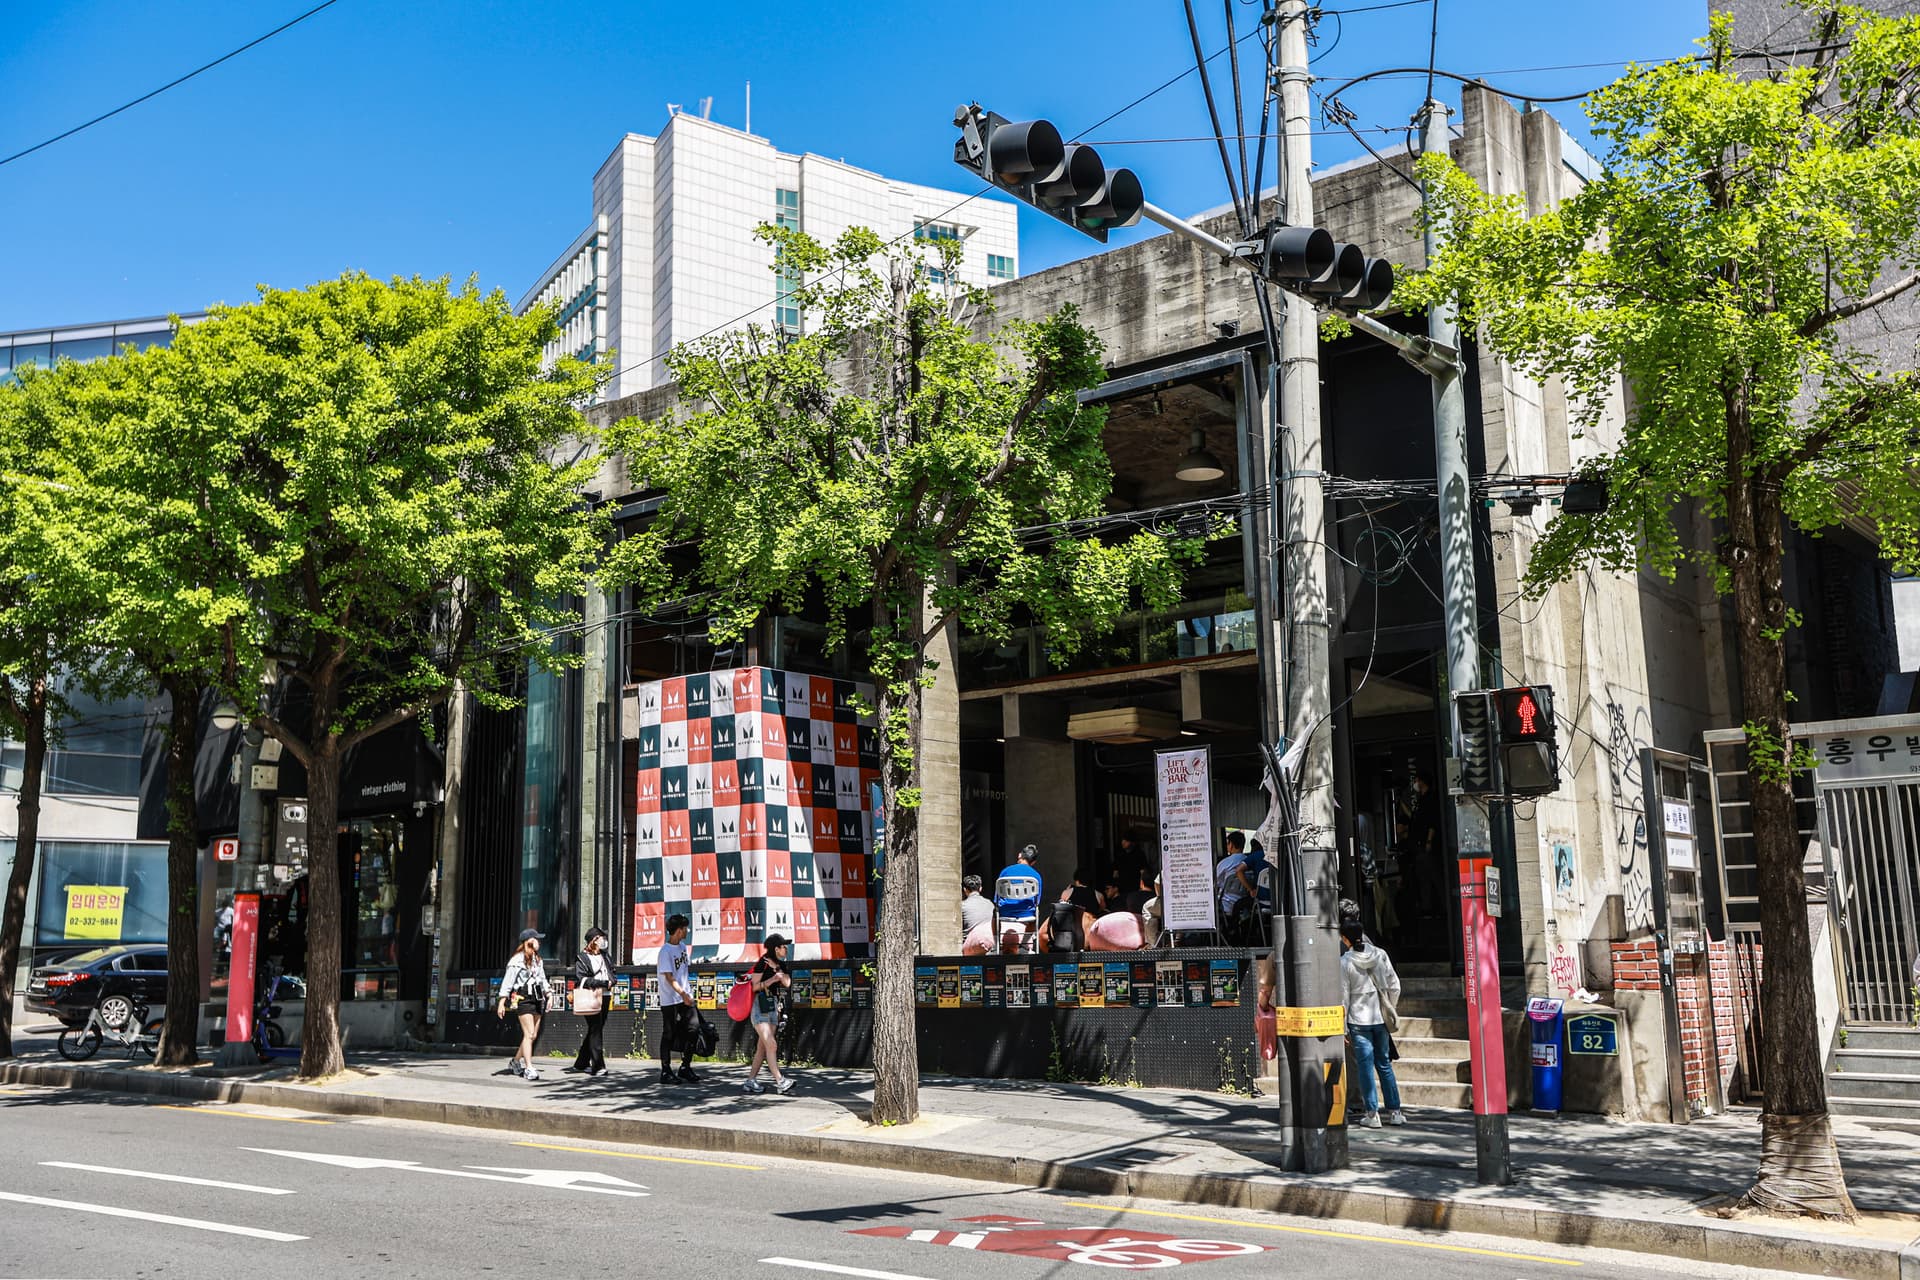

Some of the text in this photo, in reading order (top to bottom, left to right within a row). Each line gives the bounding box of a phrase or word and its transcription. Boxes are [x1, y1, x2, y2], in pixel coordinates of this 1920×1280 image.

[1168, 758, 1185, 768] LIFT
[1165, 766, 1190, 776] YOUR
[1168, 774, 1188, 785] BAR
[384, 780, 406, 792] clothing
[1488, 881, 1498, 896] 82
[72, 894, 120, 910] 임대문의
[1582, 1034, 1604, 1049] 82
